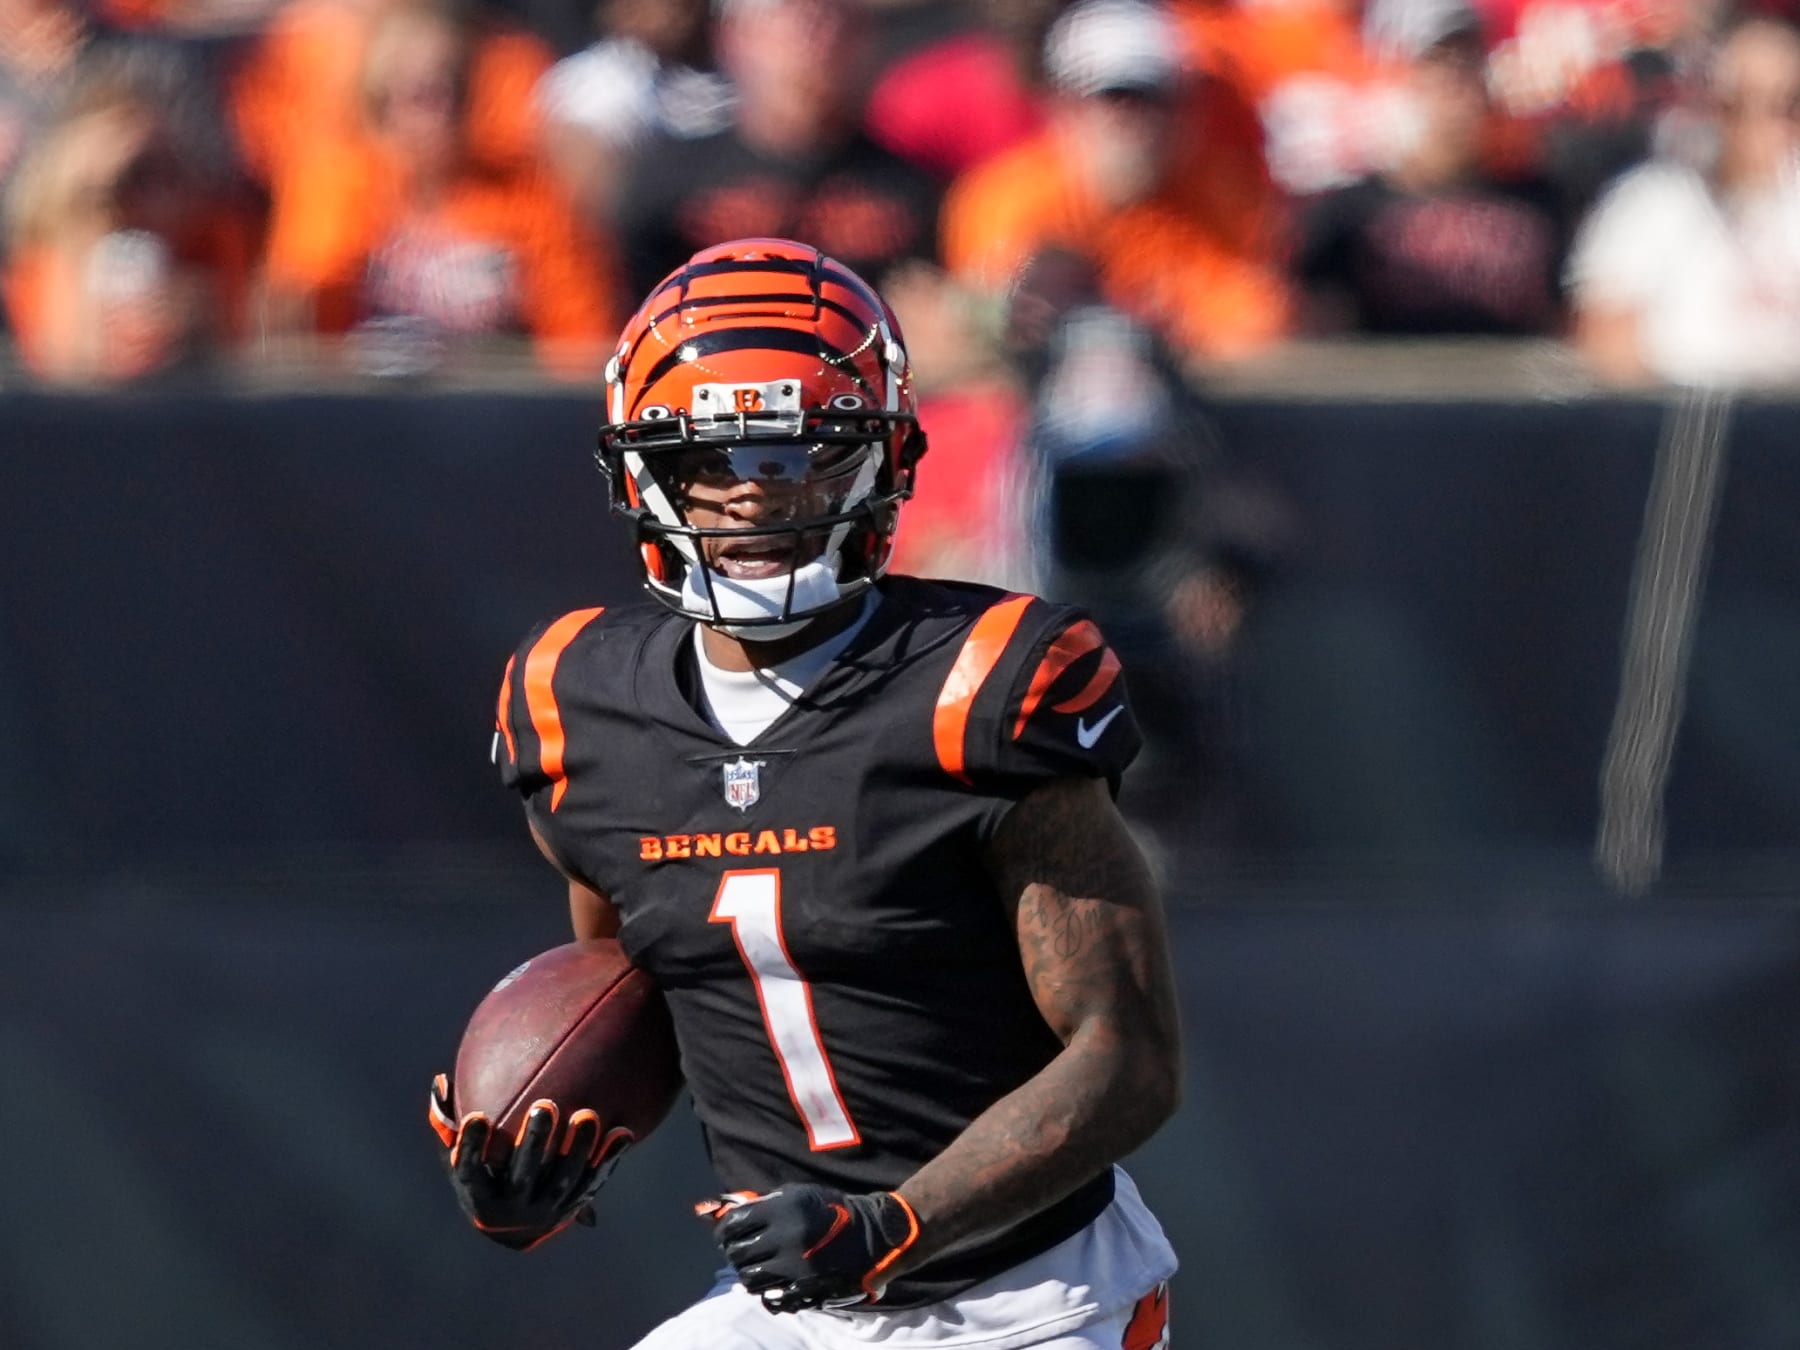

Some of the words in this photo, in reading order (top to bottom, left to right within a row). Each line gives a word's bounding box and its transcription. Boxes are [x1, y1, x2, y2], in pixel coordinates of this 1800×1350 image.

[730, 782, 756, 801] NFL
[640, 826, 836, 860] BENGALS
[707, 868, 861, 1151] 1
